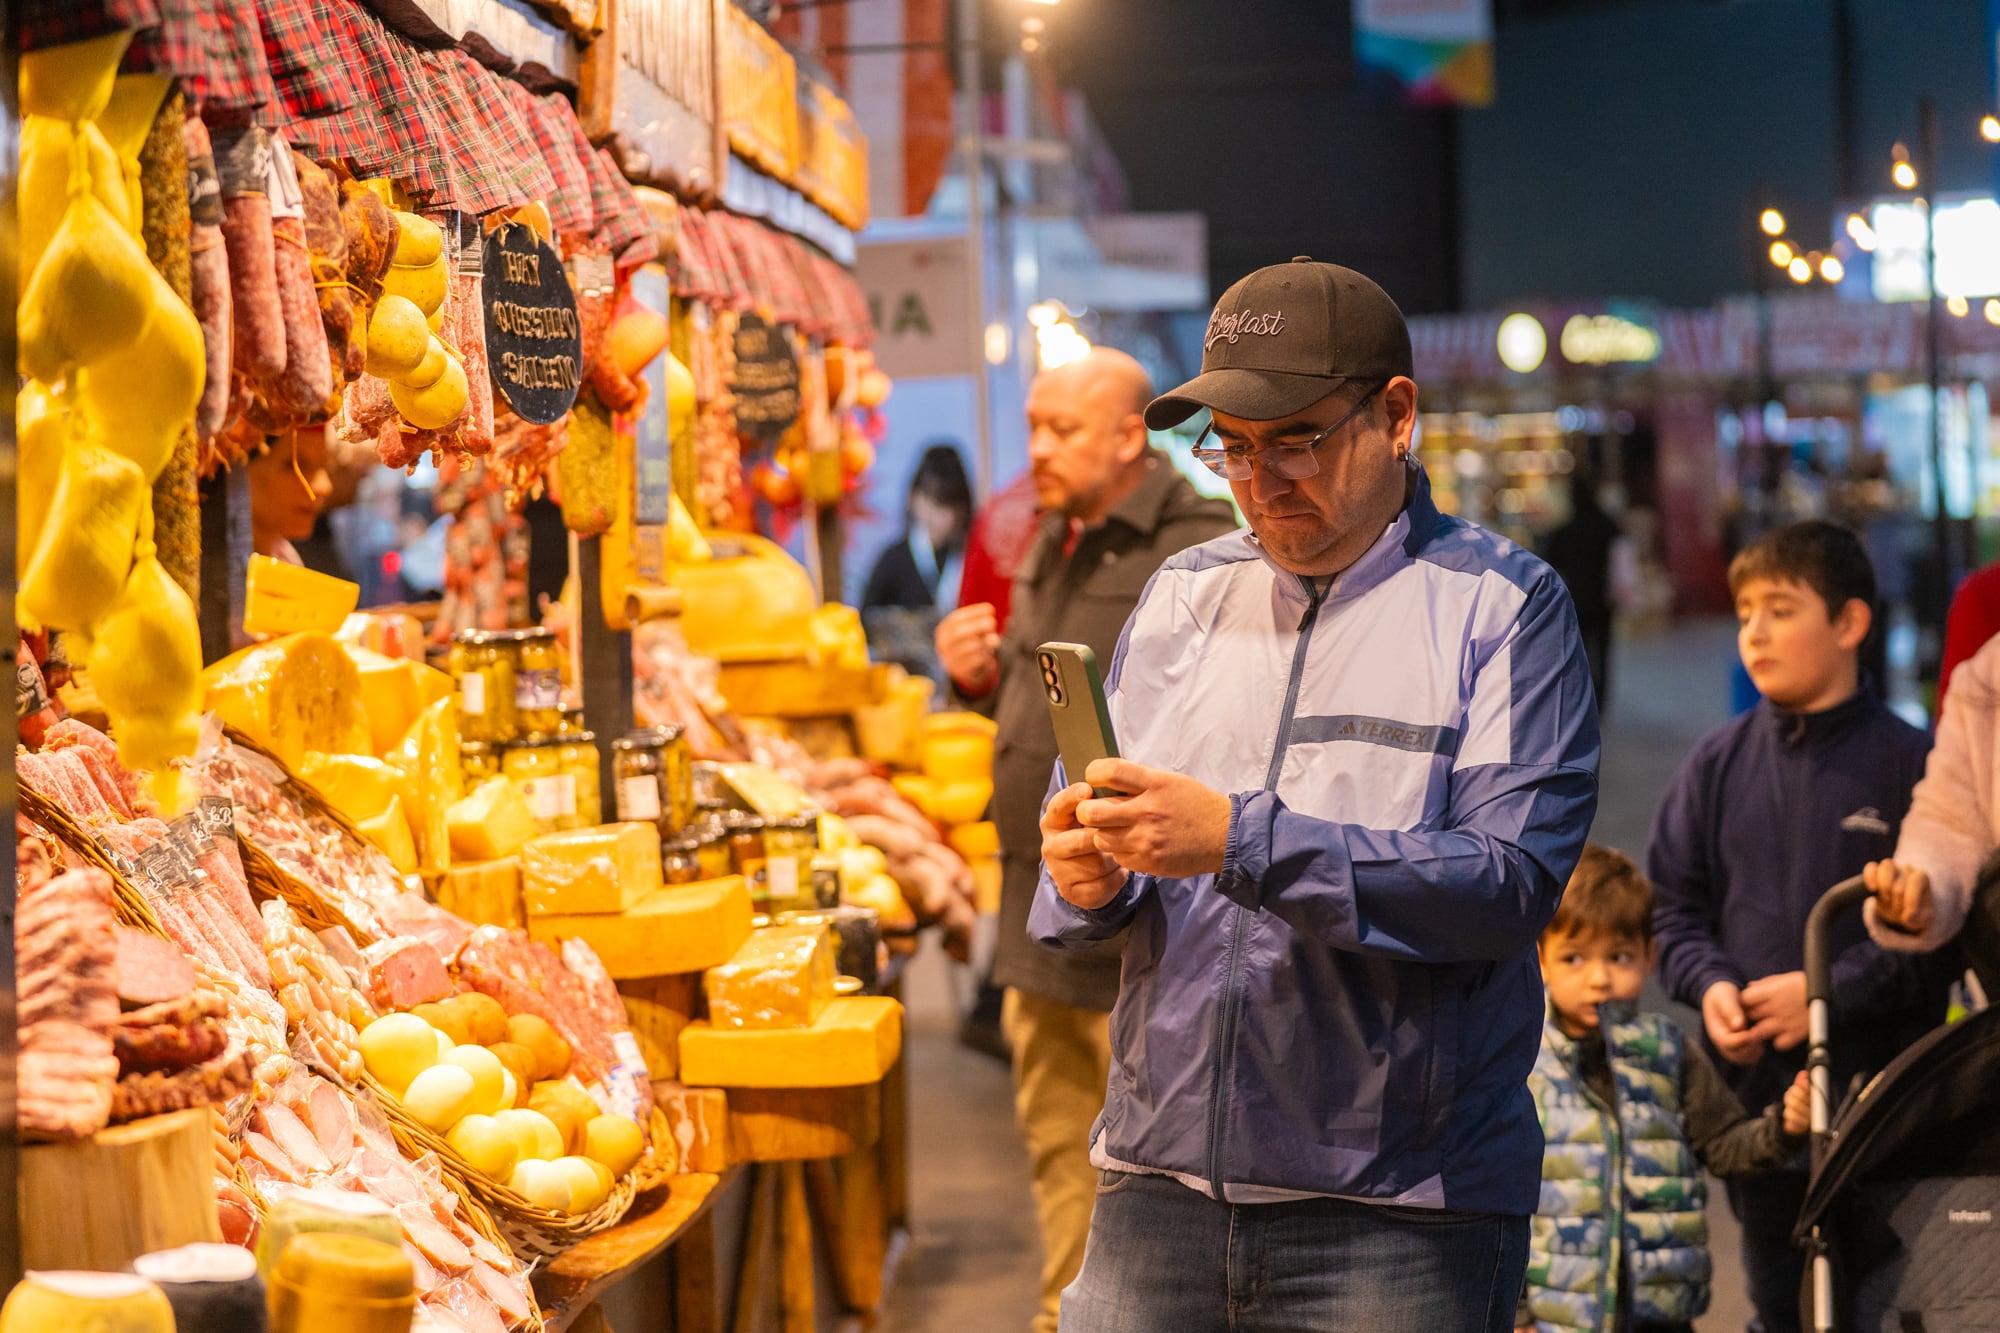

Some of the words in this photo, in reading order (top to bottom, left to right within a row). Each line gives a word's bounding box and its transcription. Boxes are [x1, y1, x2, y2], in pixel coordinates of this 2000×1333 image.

[501, 251, 541, 286] HAY
[493, 301, 577, 340] QUESILLO
[1360, 721, 1427, 746] TERREX
